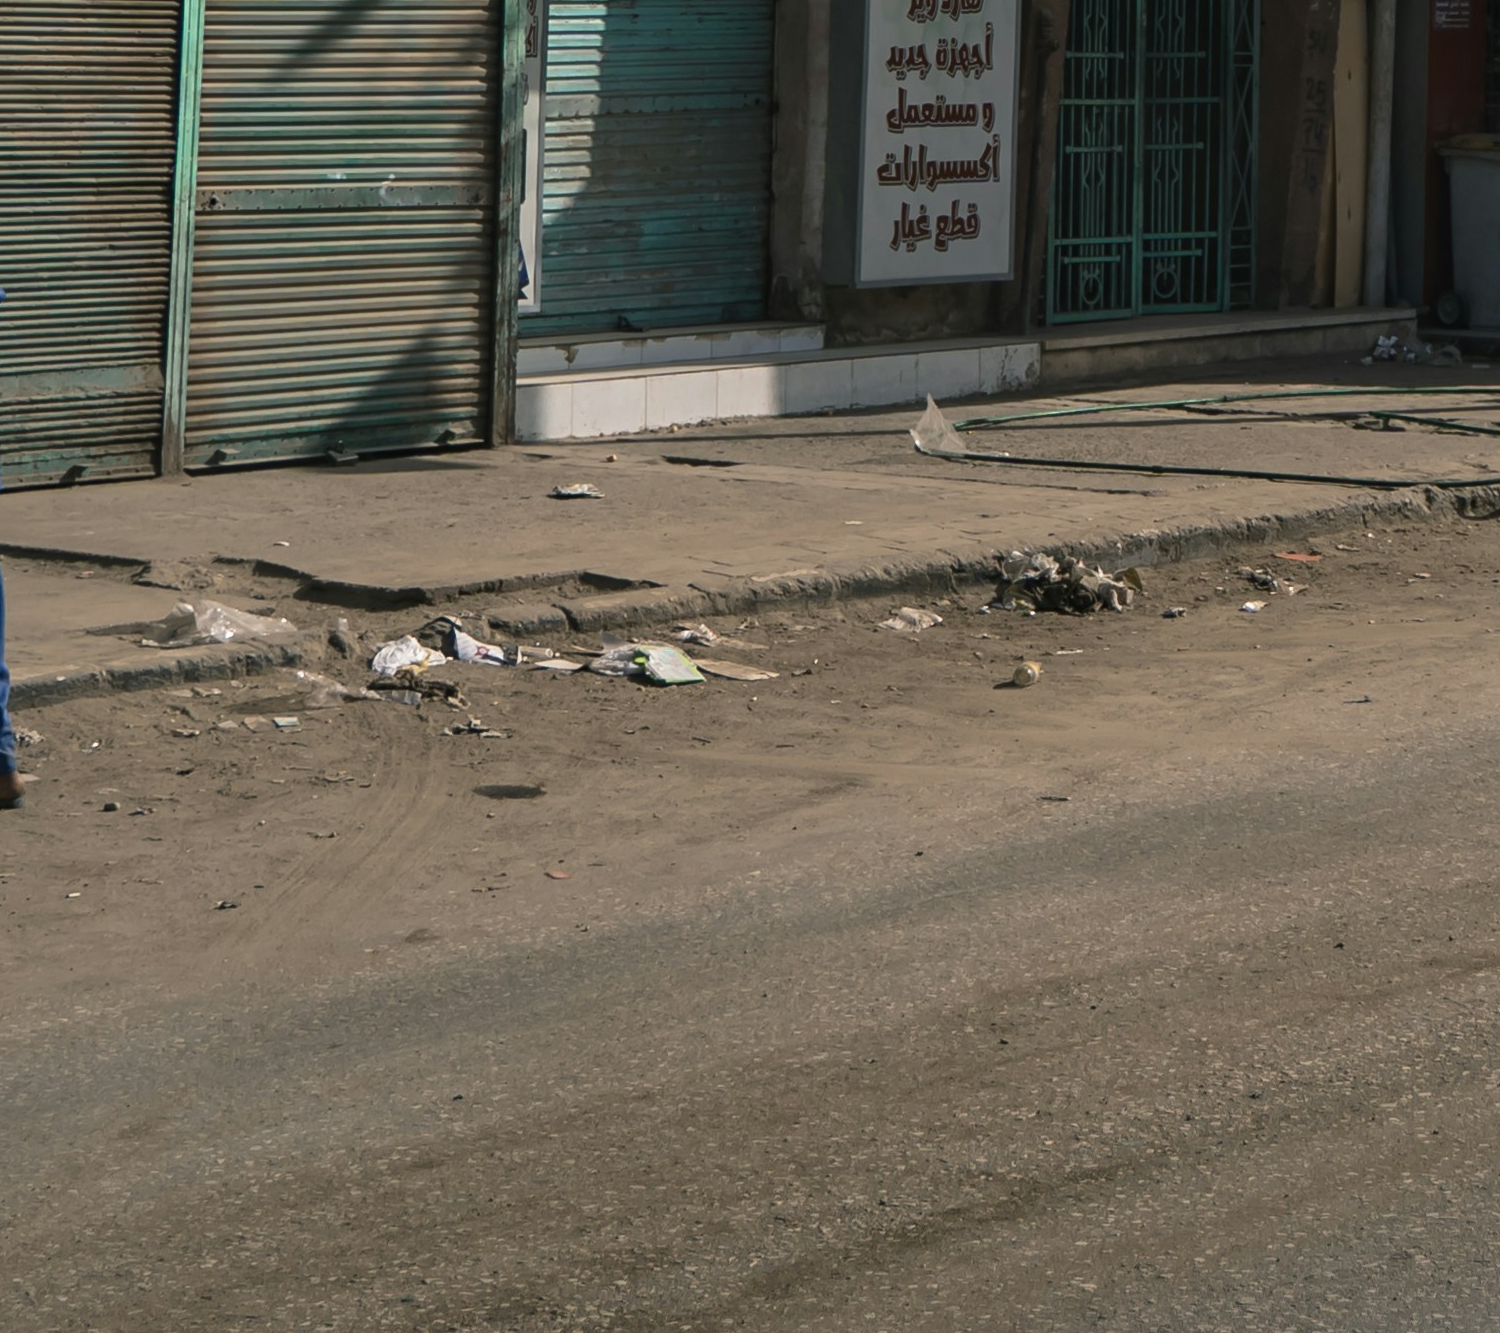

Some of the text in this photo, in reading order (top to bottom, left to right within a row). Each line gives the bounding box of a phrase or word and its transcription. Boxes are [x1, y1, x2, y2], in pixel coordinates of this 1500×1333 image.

[935, 21, 994, 80] أجهزة
[885, 86, 979, 133] مستعمل
[890, 199, 982, 252] قطع غيار
